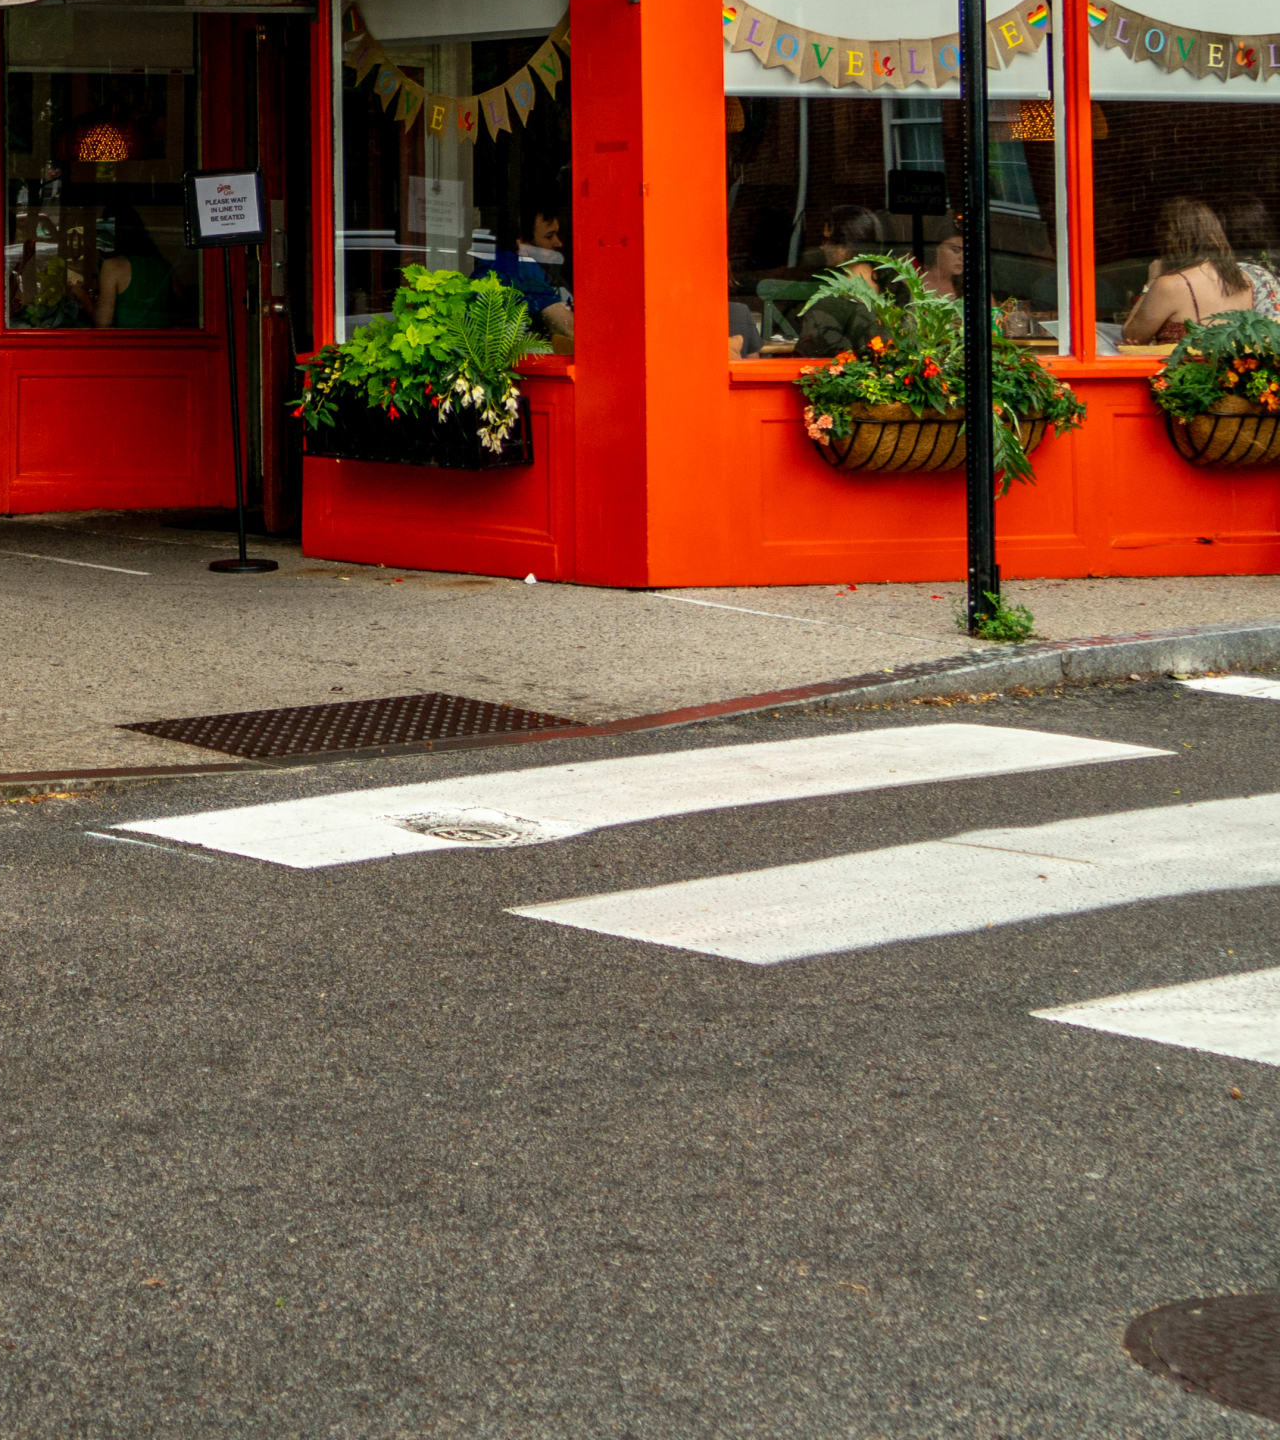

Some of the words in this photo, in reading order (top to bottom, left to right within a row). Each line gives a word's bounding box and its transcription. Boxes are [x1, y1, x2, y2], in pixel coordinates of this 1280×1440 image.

[744, 18, 864, 77] LOVE
[873, 43, 897, 78] is
[906, 20, 1025, 77] LOE
[1115, 17, 1224, 68] LOVE
[1235, 40, 1257, 69] is
[220, 214, 245, 222] SEATED
